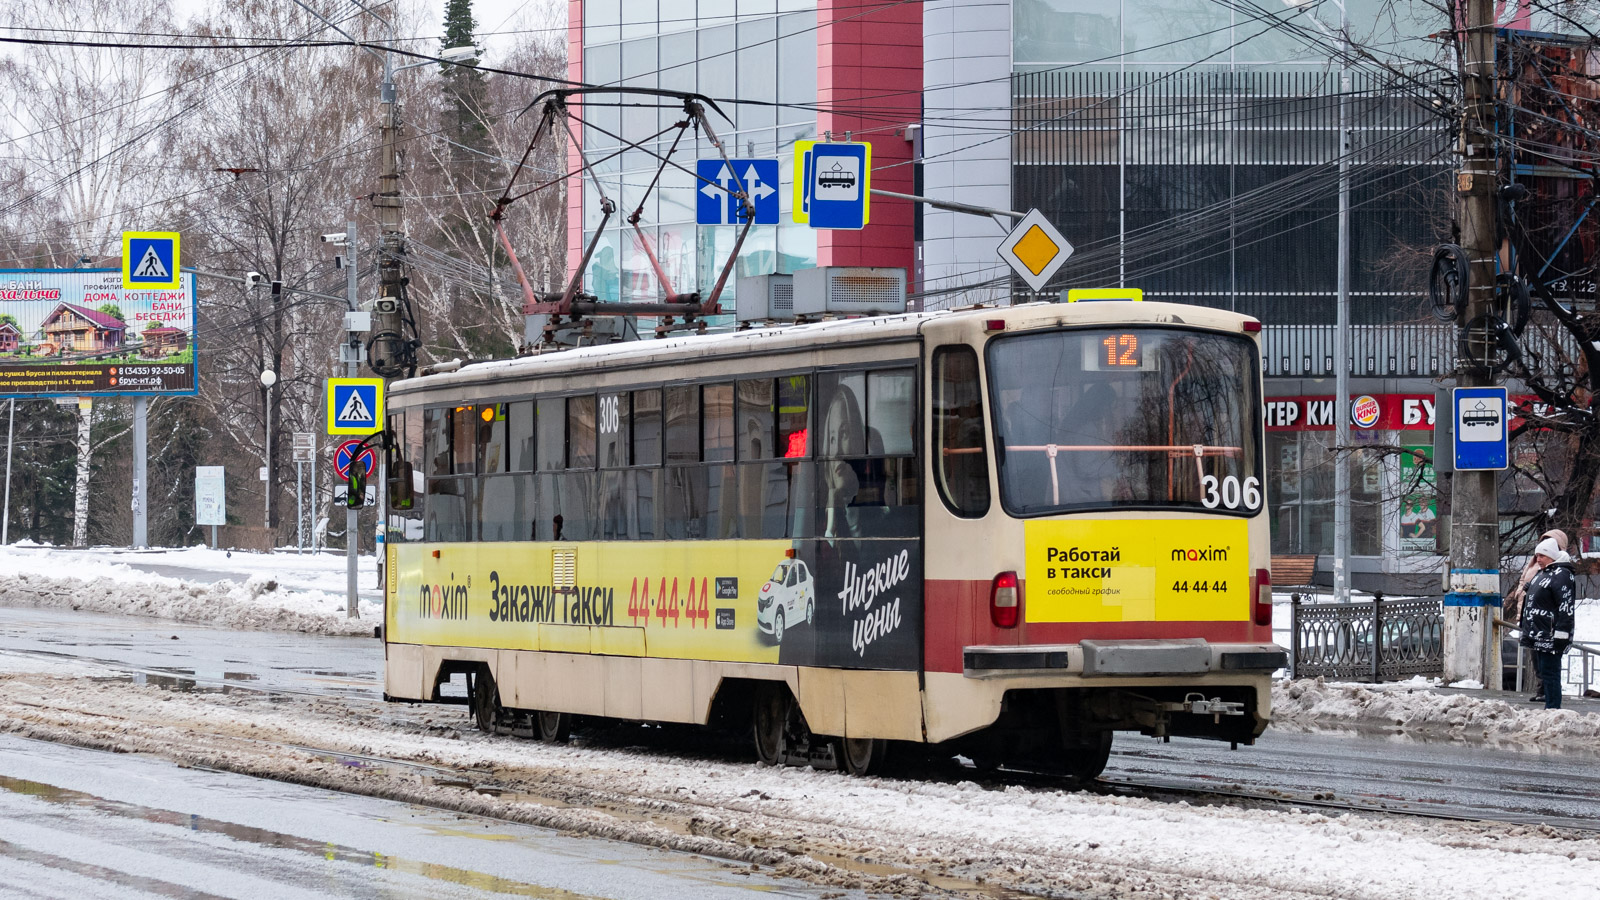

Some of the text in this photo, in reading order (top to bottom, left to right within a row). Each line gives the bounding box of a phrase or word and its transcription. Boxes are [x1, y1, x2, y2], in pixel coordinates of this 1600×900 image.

[9, 280, 42, 290] БАНИ
[84, 292, 185, 302] ДОМА, КОТТЕДЖИ
[152, 302, 185, 312] БАНИ,
[135, 312, 186, 321] БЕСЕДКИ
[1104, 334, 1137, 365] 12
[4, 370, 25, 378] сушка
[26, 370, 46, 378] бруса
[118, 366, 186, 375] 8 (3435) 92-50-05
[1307, 400, 1338, 425] КИ
[1356, 401, 1376, 413] BURGER
[1357, 406, 1377, 420] KING
[600, 396, 619, 434] 306
[1201, 475, 1261, 510] 306
[1047, 547, 1121, 562] Работай
[1047, 567, 1112, 579] в такси
[838, 549, 910, 616] Низкие
[1047, 587, 1121, 596] свободный график
[489, 570, 614, 627] Закажи такси
[852, 597, 902, 658] цены
